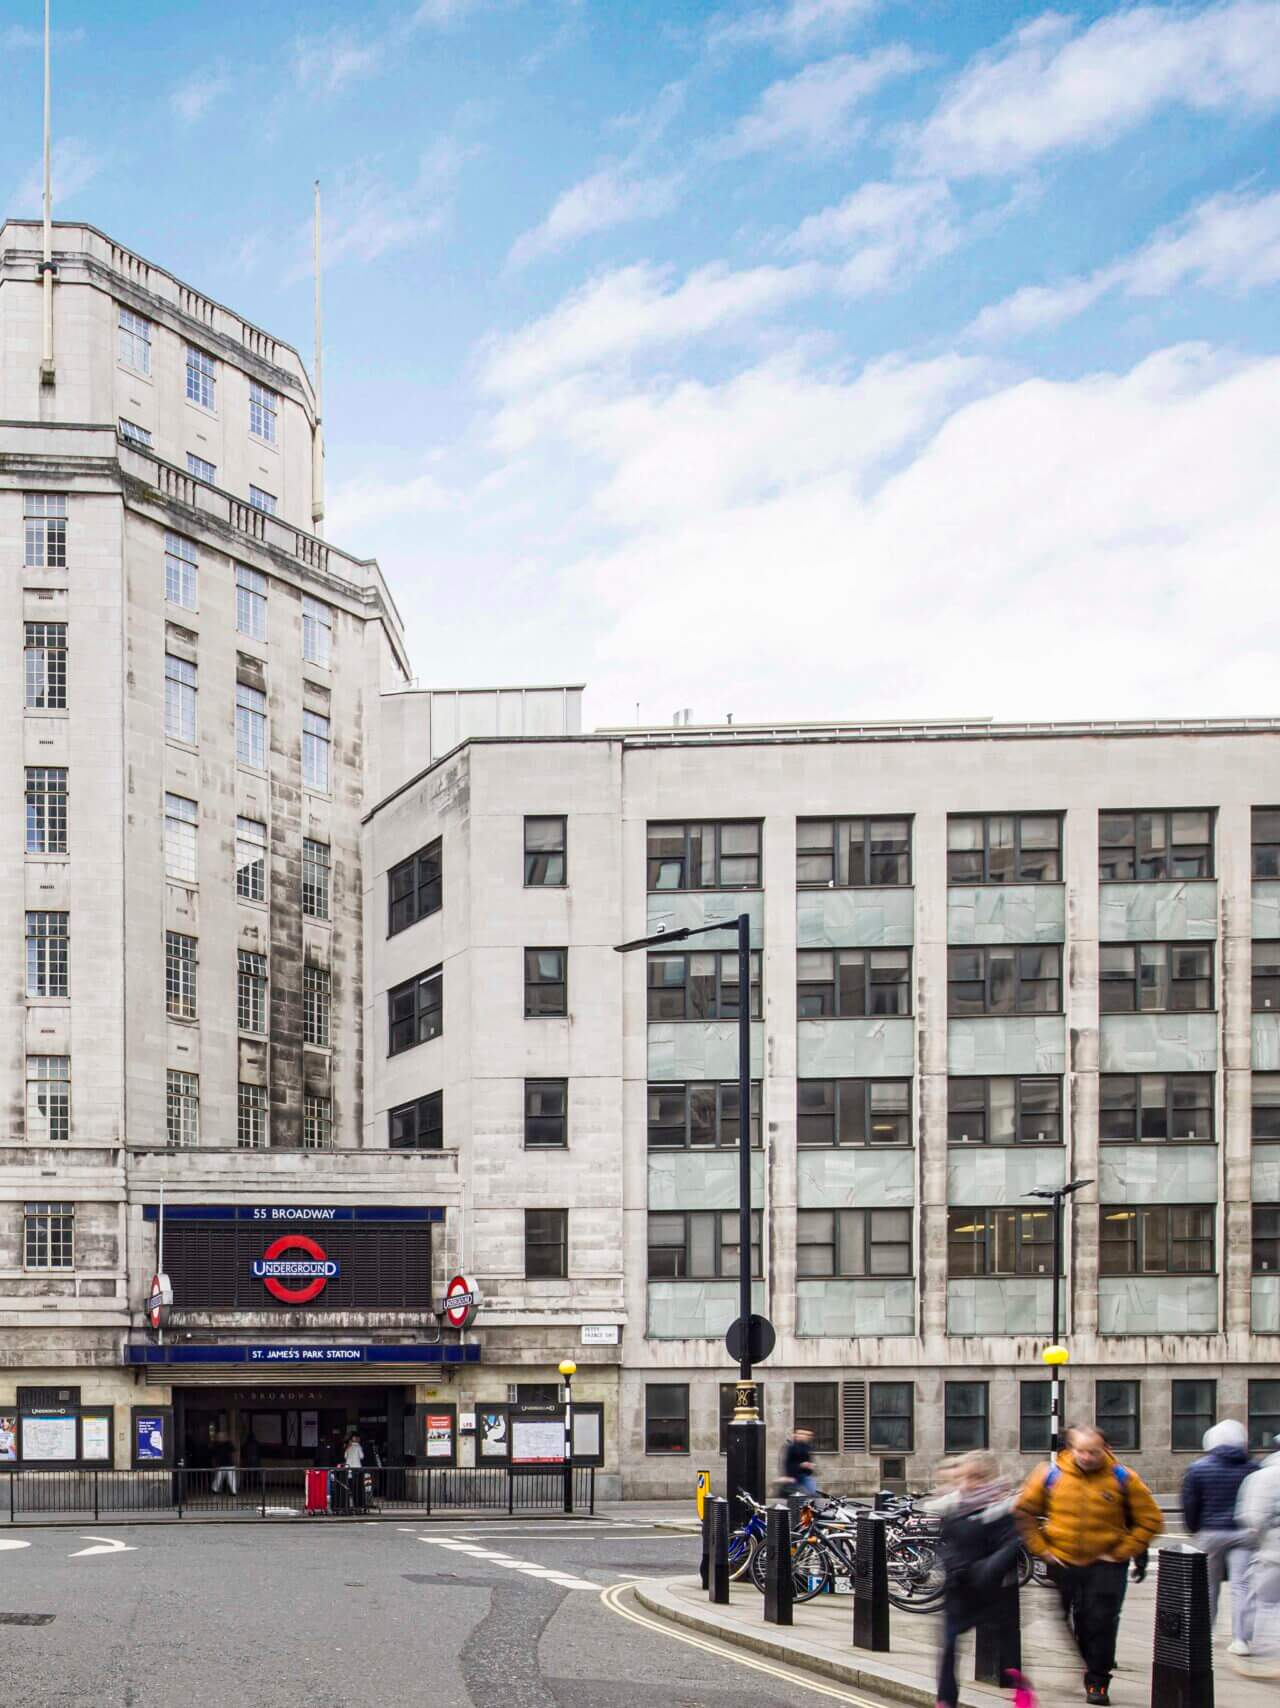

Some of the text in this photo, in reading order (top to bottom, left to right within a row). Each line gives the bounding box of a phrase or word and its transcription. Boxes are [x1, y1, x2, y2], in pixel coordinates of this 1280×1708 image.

[253, 1208, 336, 1219] 55 BROADWAY
[253, 1261, 337, 1276] UNDERGROUND
[252, 1350, 264, 1359] ST.
[302, 1350, 324, 1359] PARK
[326, 1350, 361, 1359] STATION
